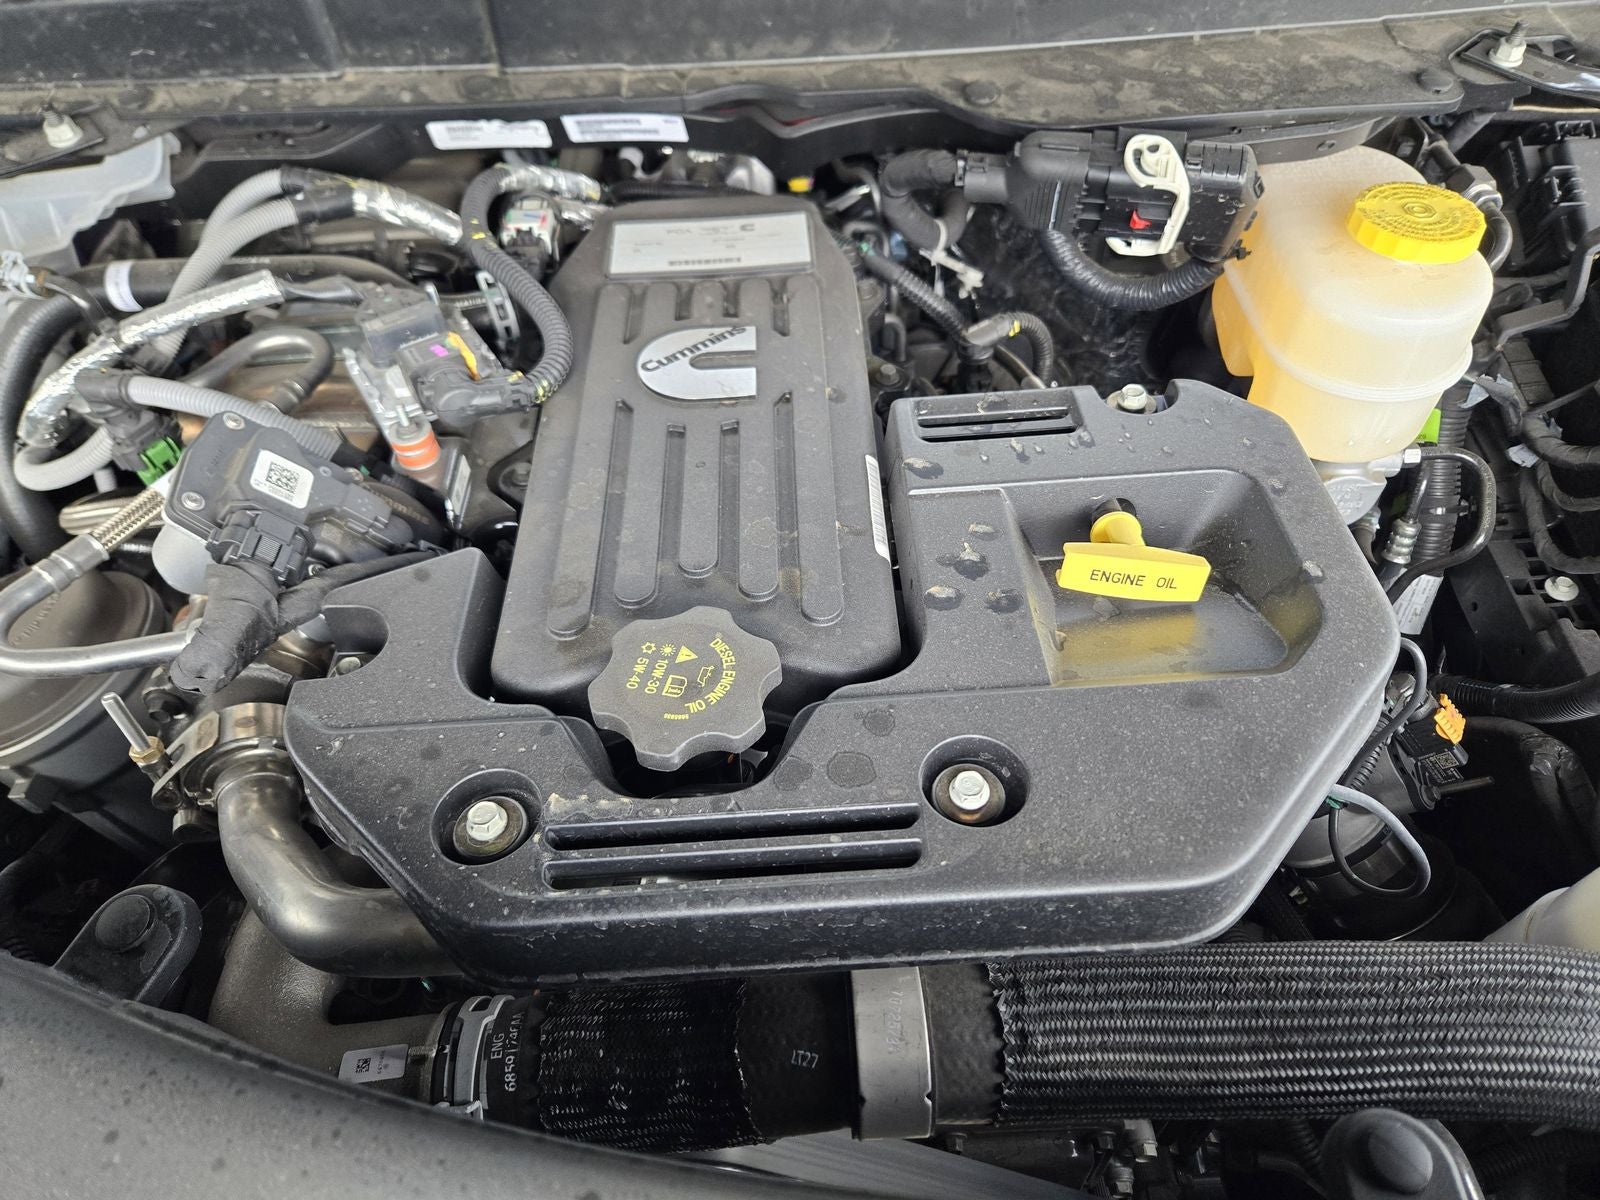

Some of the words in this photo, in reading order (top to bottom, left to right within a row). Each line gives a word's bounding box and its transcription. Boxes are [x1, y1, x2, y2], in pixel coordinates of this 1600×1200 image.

[641, 326, 747, 372] Cummins
[1090, 569, 1146, 587] ENGINE
[1156, 577, 1177, 589] OIL
[709, 638, 736, 669] DIESEL
[626, 657, 650, 689] 5W-40
[644, 659, 669, 694] 10W-30
[704, 670, 736, 705] ENGINE
[684, 699, 706, 713] OIL
[490, 1033, 505, 1060] ENG
